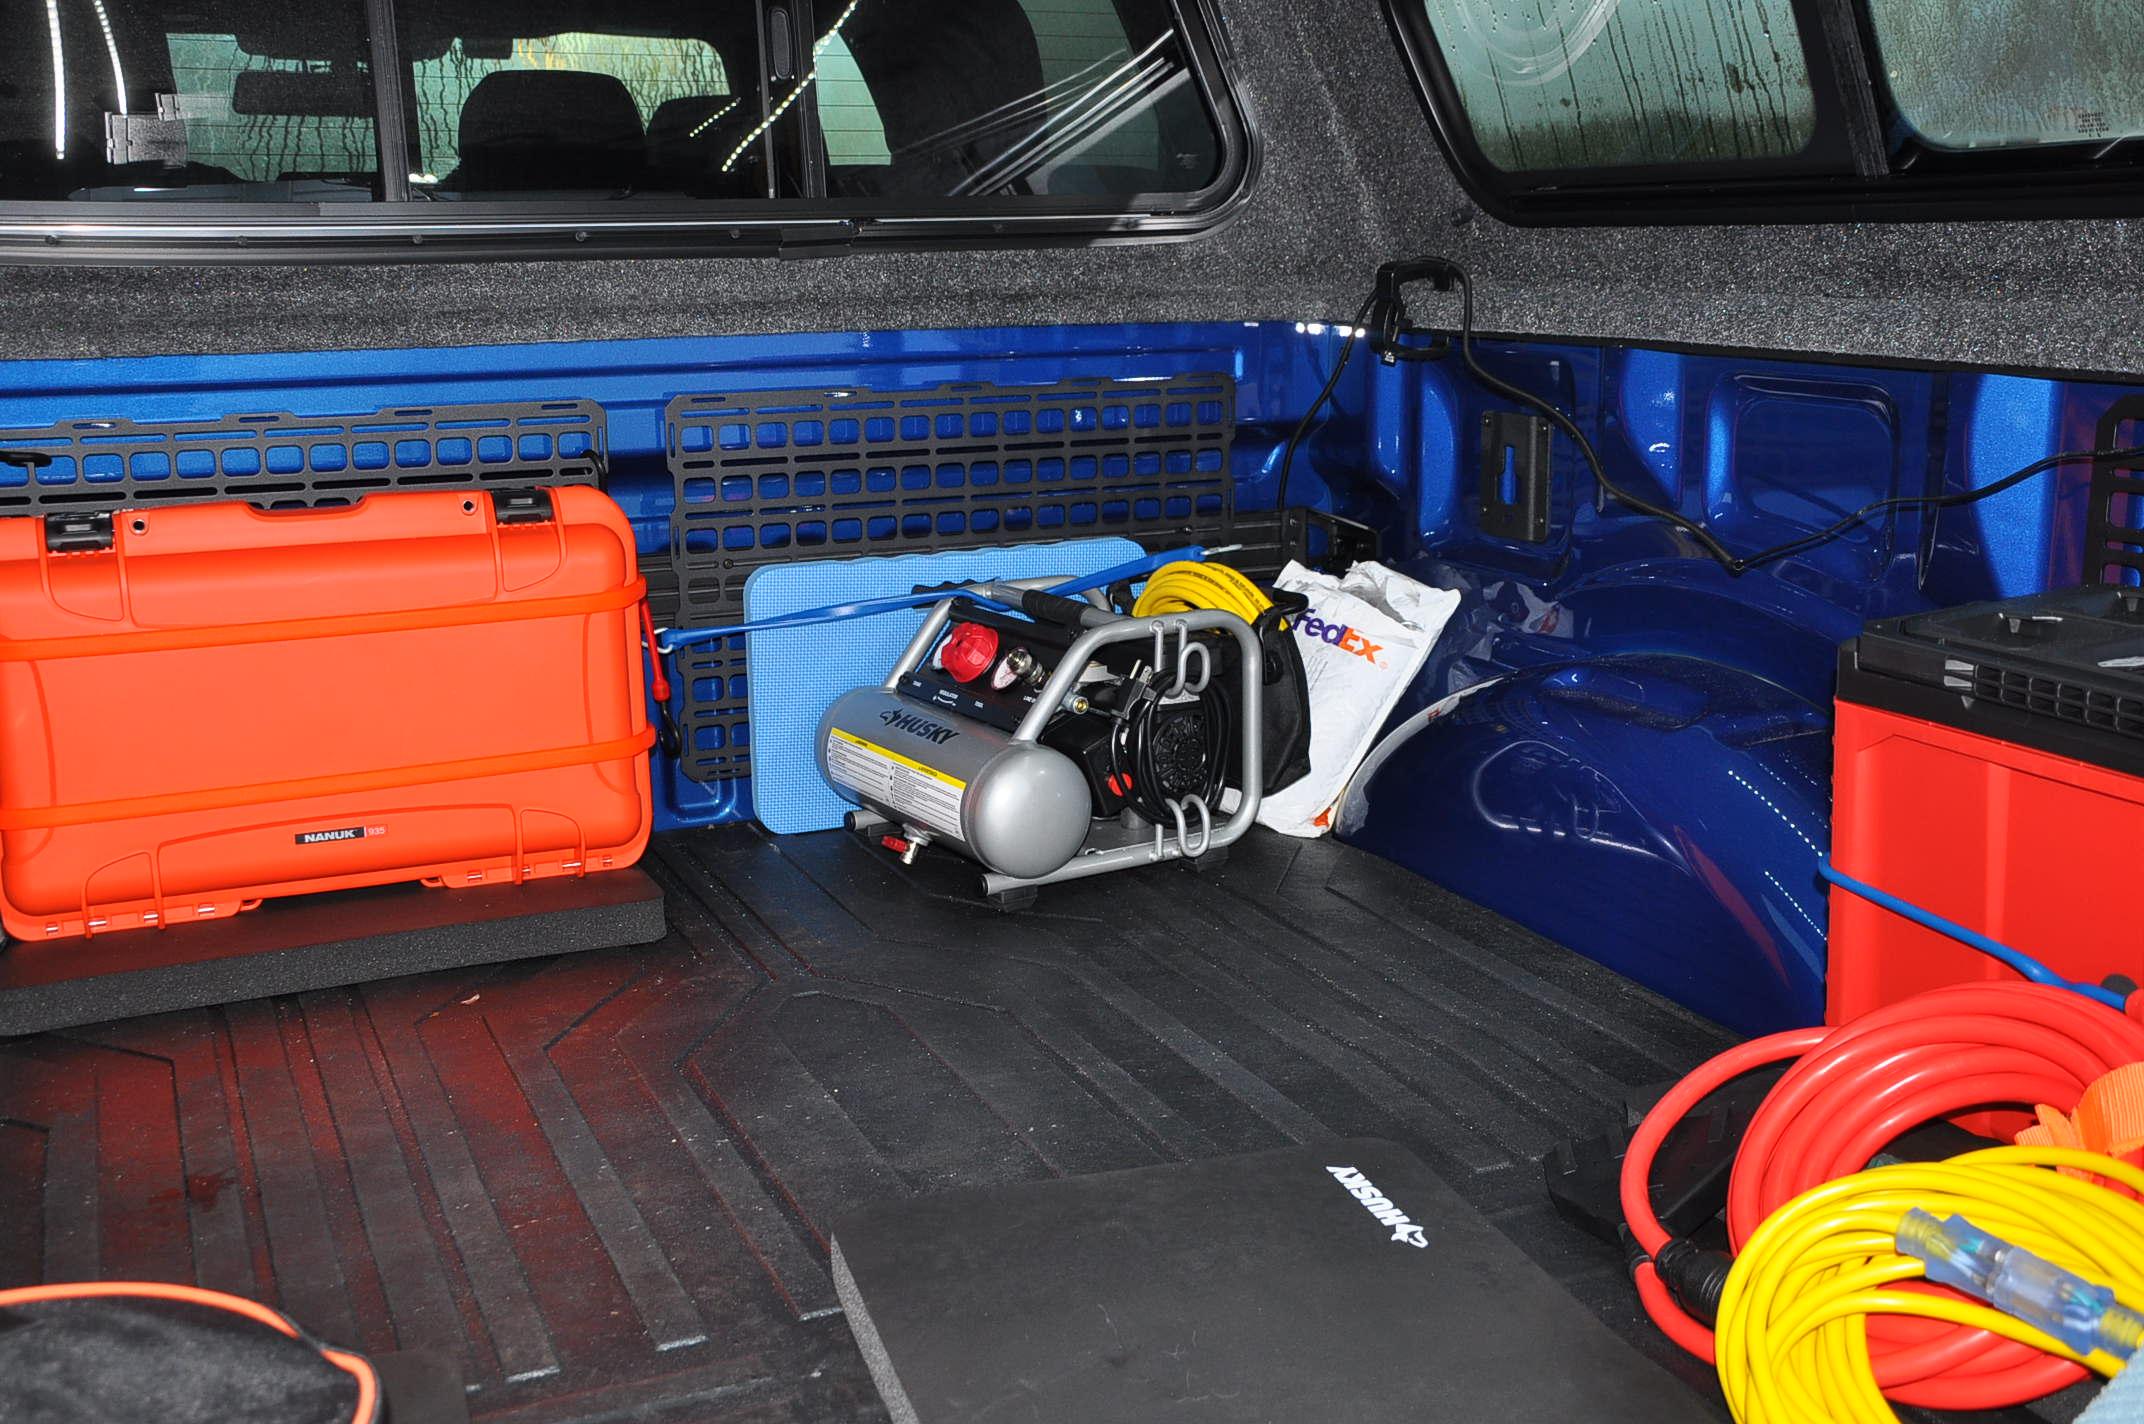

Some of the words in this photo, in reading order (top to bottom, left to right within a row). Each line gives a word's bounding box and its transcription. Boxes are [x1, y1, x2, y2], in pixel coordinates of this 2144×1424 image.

[1292, 608, 1384, 665] FedEx
[894, 714, 960, 745] HUSKY
[304, 829, 356, 843] NANUK
[368, 826, 386, 836] 935
[1325, 1166, 1411, 1227] HUSKY
